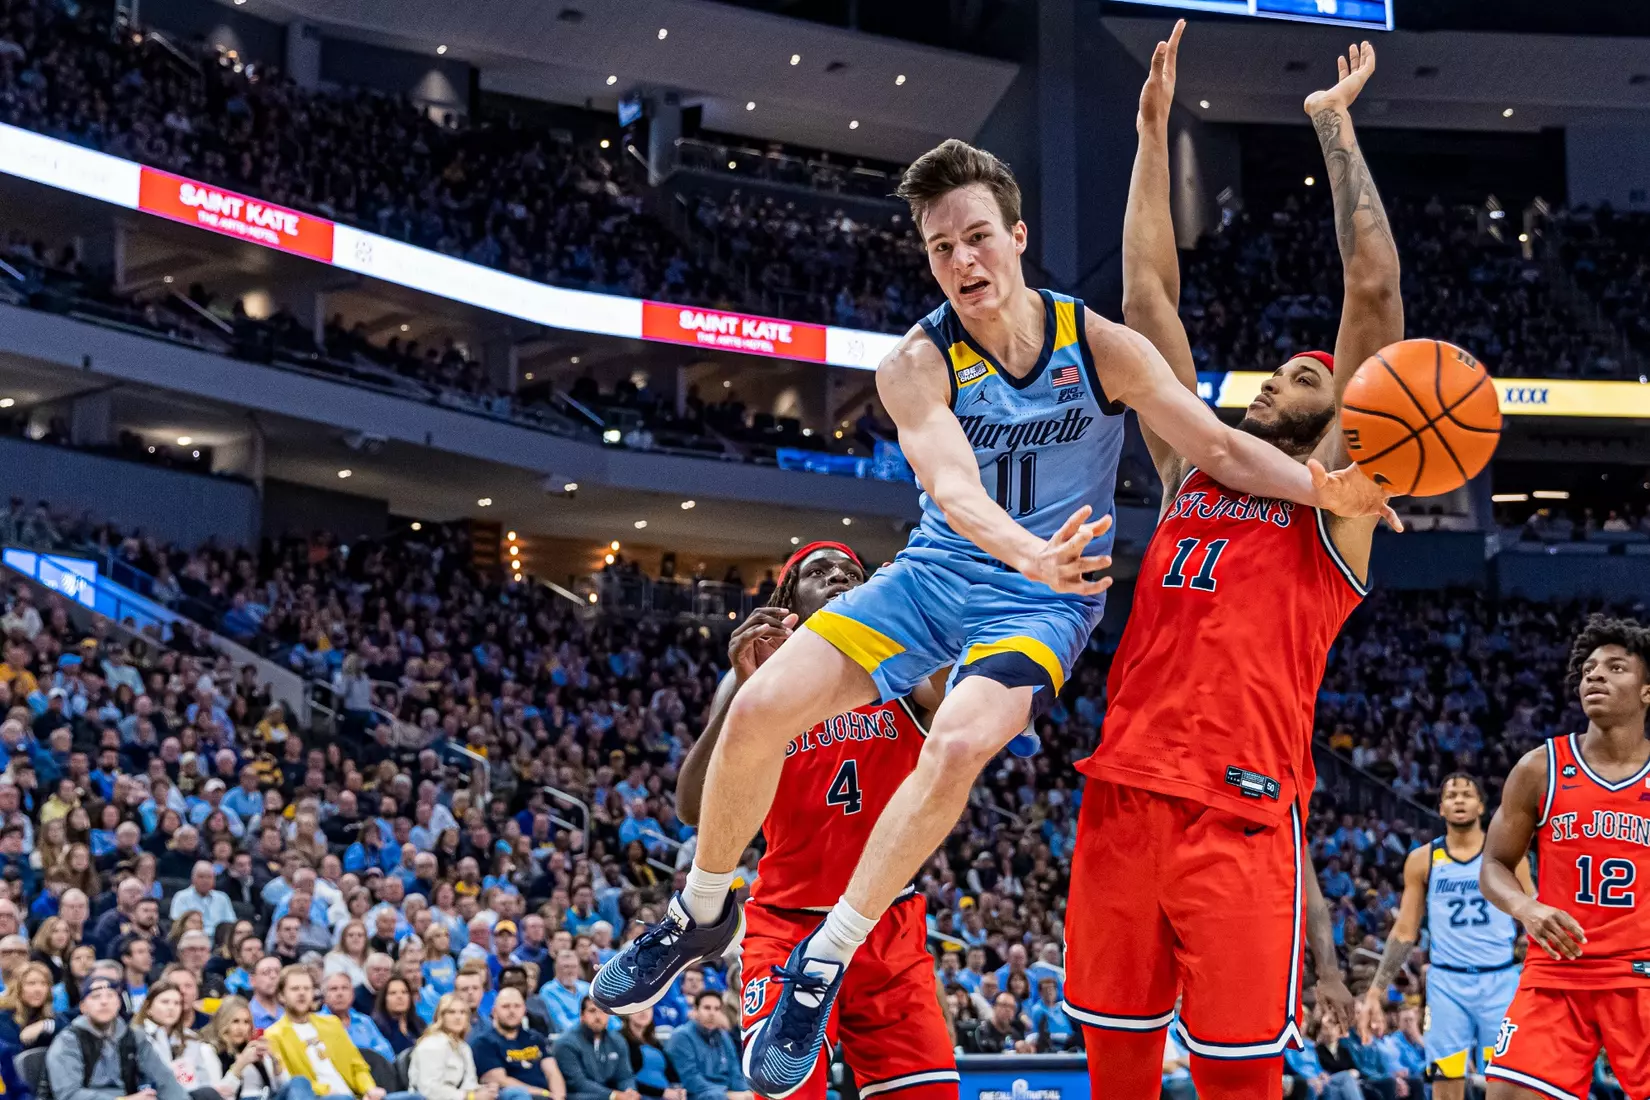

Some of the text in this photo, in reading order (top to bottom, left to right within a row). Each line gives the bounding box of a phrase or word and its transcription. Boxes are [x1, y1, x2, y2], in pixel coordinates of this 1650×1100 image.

[180, 184, 300, 236] SAINT KATE
[197, 210, 219, 226] THE
[679, 309, 792, 343] SAINT KATE
[697, 331, 716, 344] THE
[1058, 392, 1085, 403] EAST
[1060, 386, 1079, 395] BIG
[957, 408, 1094, 453] Marquette
[995, 451, 1037, 517] 11
[1162, 536, 1229, 592] 11
[817, 709, 898, 747] JOHN'S
[1562, 766, 1576, 775] JK
[826, 759, 862, 815] 4
[1550, 811, 1579, 842] ST.
[1435, 878, 1480, 894] Marqu
[1575, 854, 1636, 908] 12
[1447, 899, 1490, 926] 23
